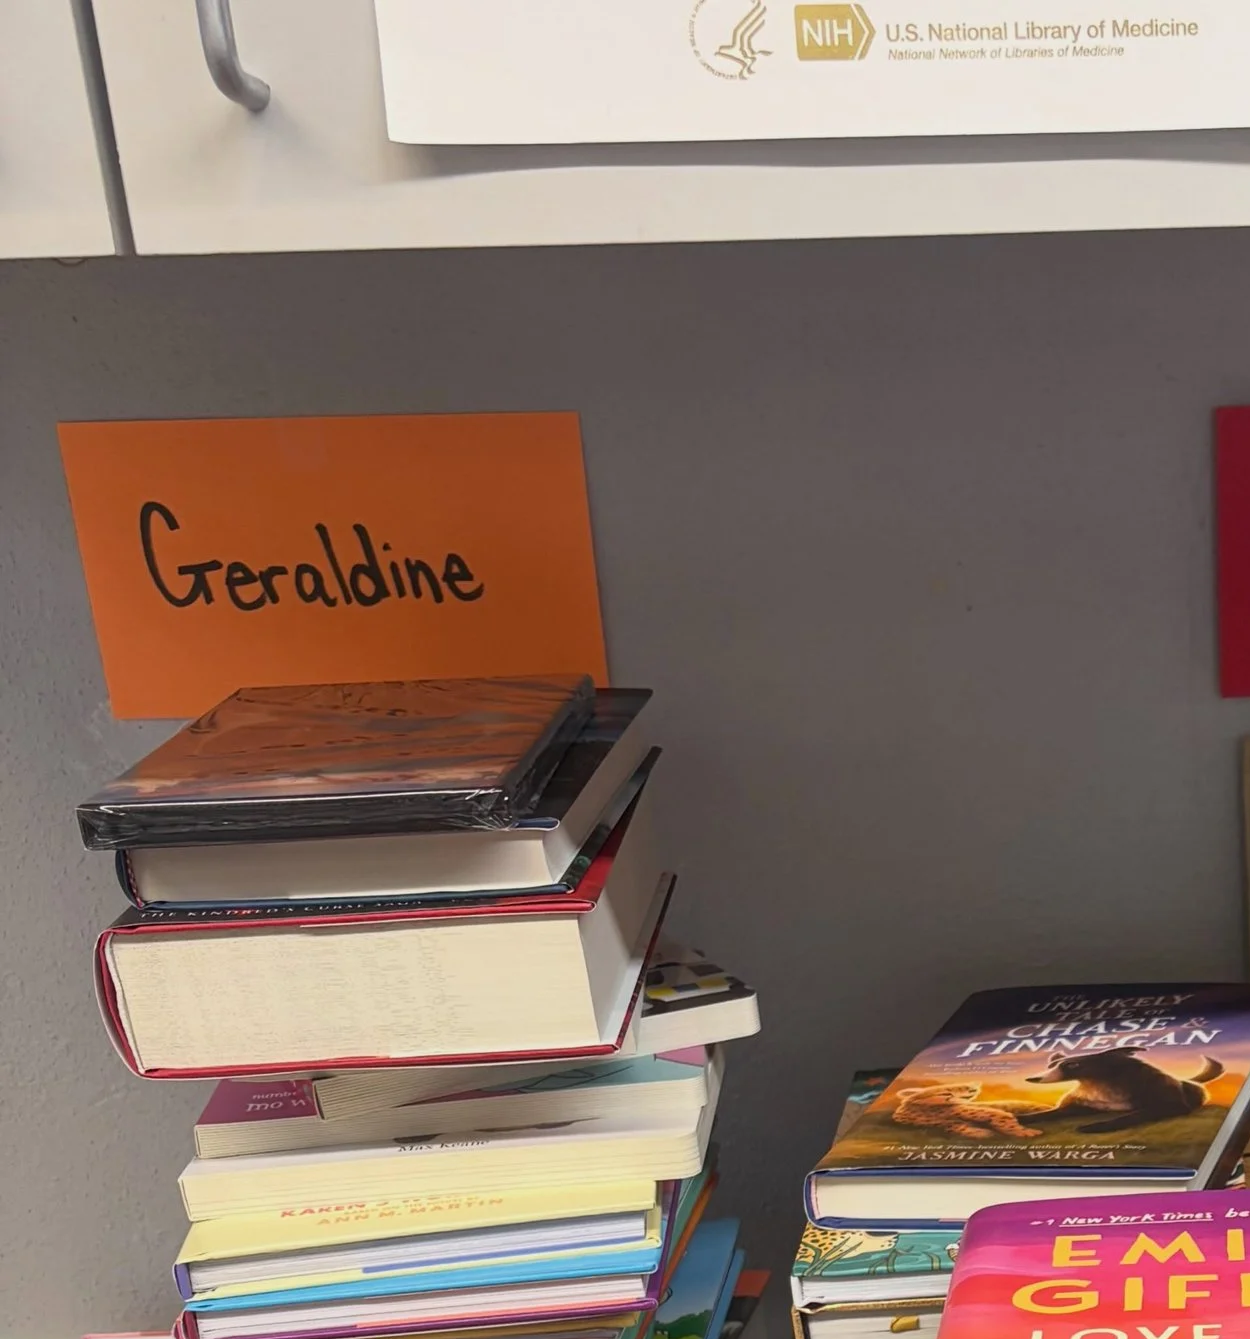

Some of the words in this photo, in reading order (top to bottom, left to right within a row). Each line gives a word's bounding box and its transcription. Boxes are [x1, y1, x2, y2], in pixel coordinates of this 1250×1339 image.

[802, 19, 855, 48] NIH
[886, 23, 924, 42] U.S.
[928, 21, 1008, 41] National
[1014, 21, 1082, 44] Library
[1086, 20, 1107, 38] of
[1112, 18, 1200, 38] Medicine
[888, 48, 936, 60] National
[940, 48, 988, 59] Network
[991, 47, 1003, 58] of
[1006, 46, 1055, 58] Libraries
[1058, 45, 1070, 57] of
[1073, 45, 1126, 57] Medicine
[138, 500, 485, 611] Geraldine
[1027, 994, 1195, 1014] UNLIKELY
[1006, 1016, 1176, 1039] CHASE
[1180, 1017, 1210, 1030] &
[956, 1029, 1223, 1059] FINNEGAN
[898, 1151, 1015, 1161] JASMINE
[1029, 1150, 1116, 1160] WARGA
[1060, 1214, 1099, 1225] New
[1108, 1212, 1155, 1223] York
[1160, 1210, 1214, 1221] Times
